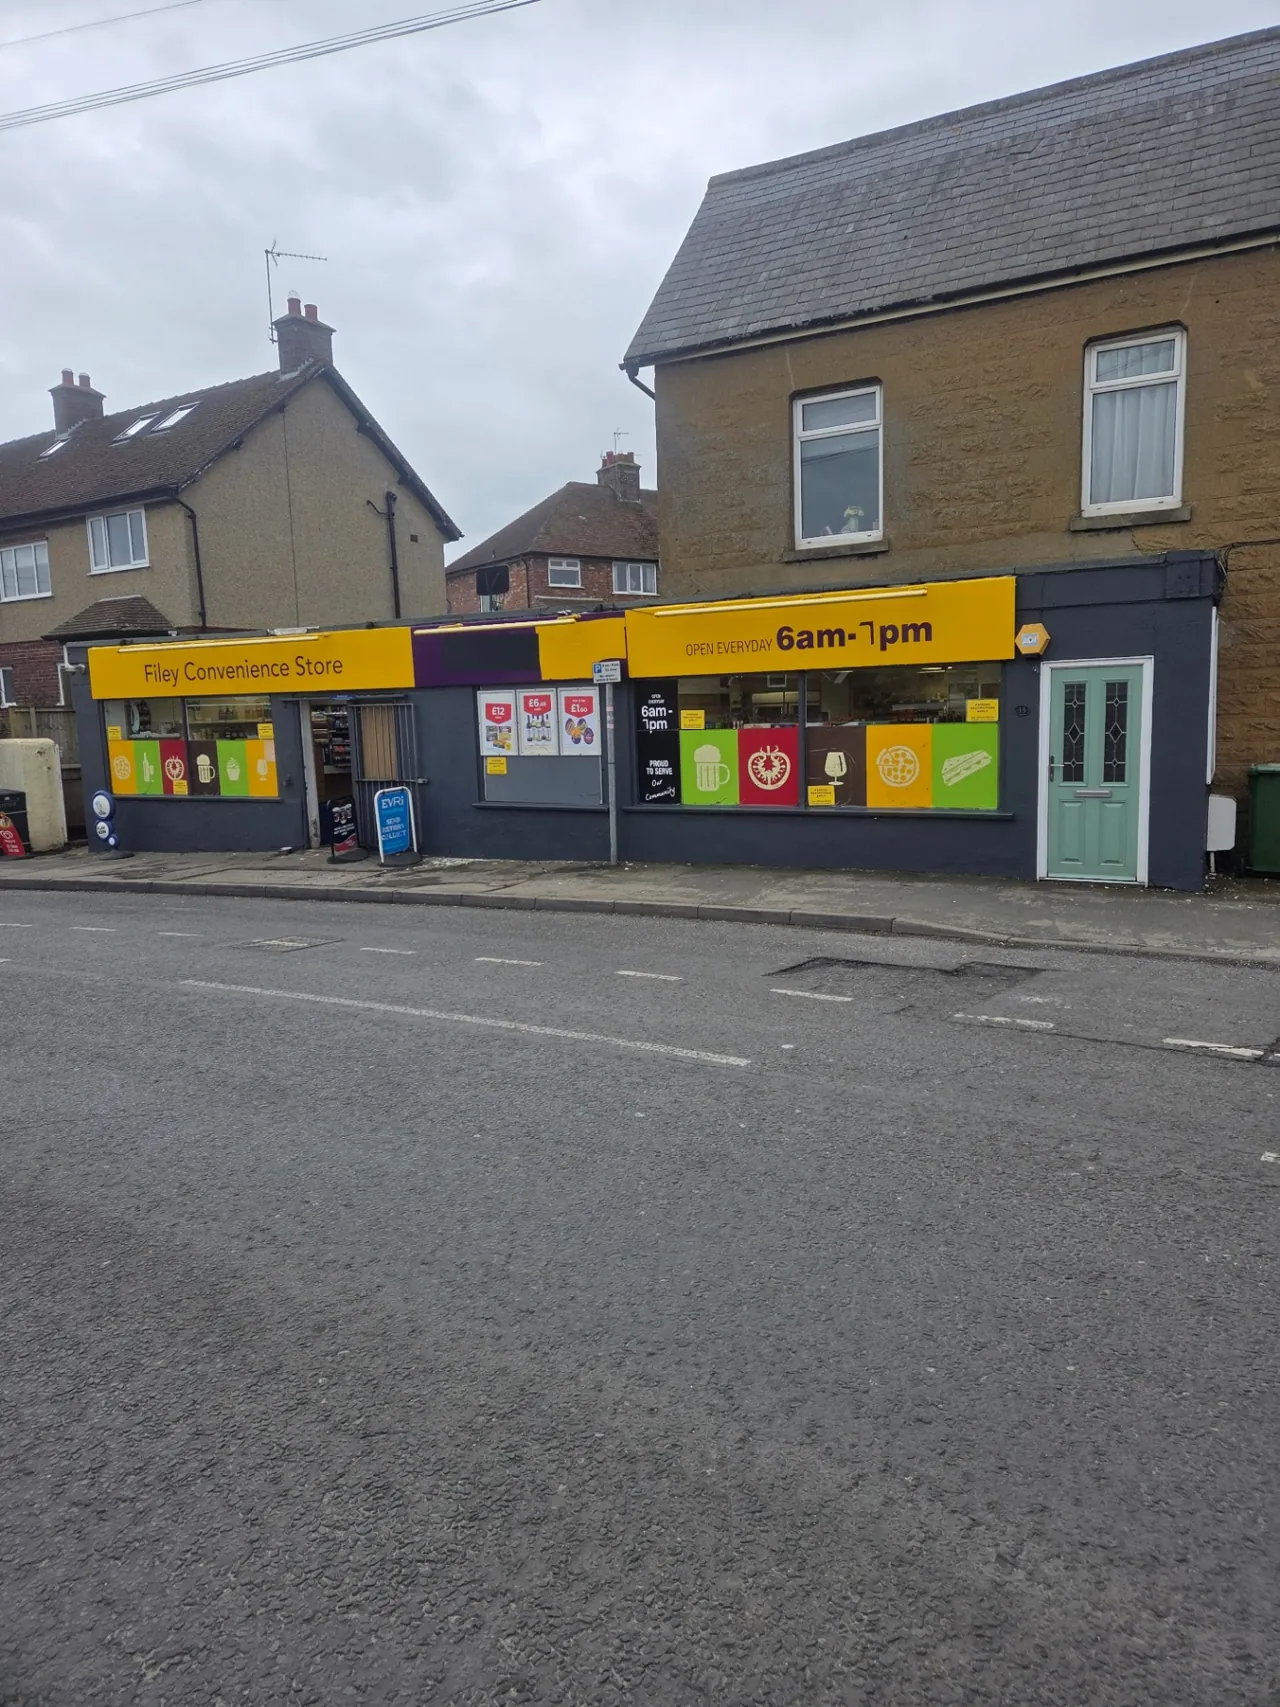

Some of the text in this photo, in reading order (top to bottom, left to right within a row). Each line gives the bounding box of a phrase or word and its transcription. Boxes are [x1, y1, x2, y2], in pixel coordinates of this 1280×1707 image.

[685, 642, 714, 657] OPEN
[717, 638, 773, 655] EVERYDAY
[143, 655, 344, 688] Filey Convenience Store
[491, 706, 505, 716] £12
[654, 767, 673, 775] SERVE
[645, 786, 676, 800] Community
